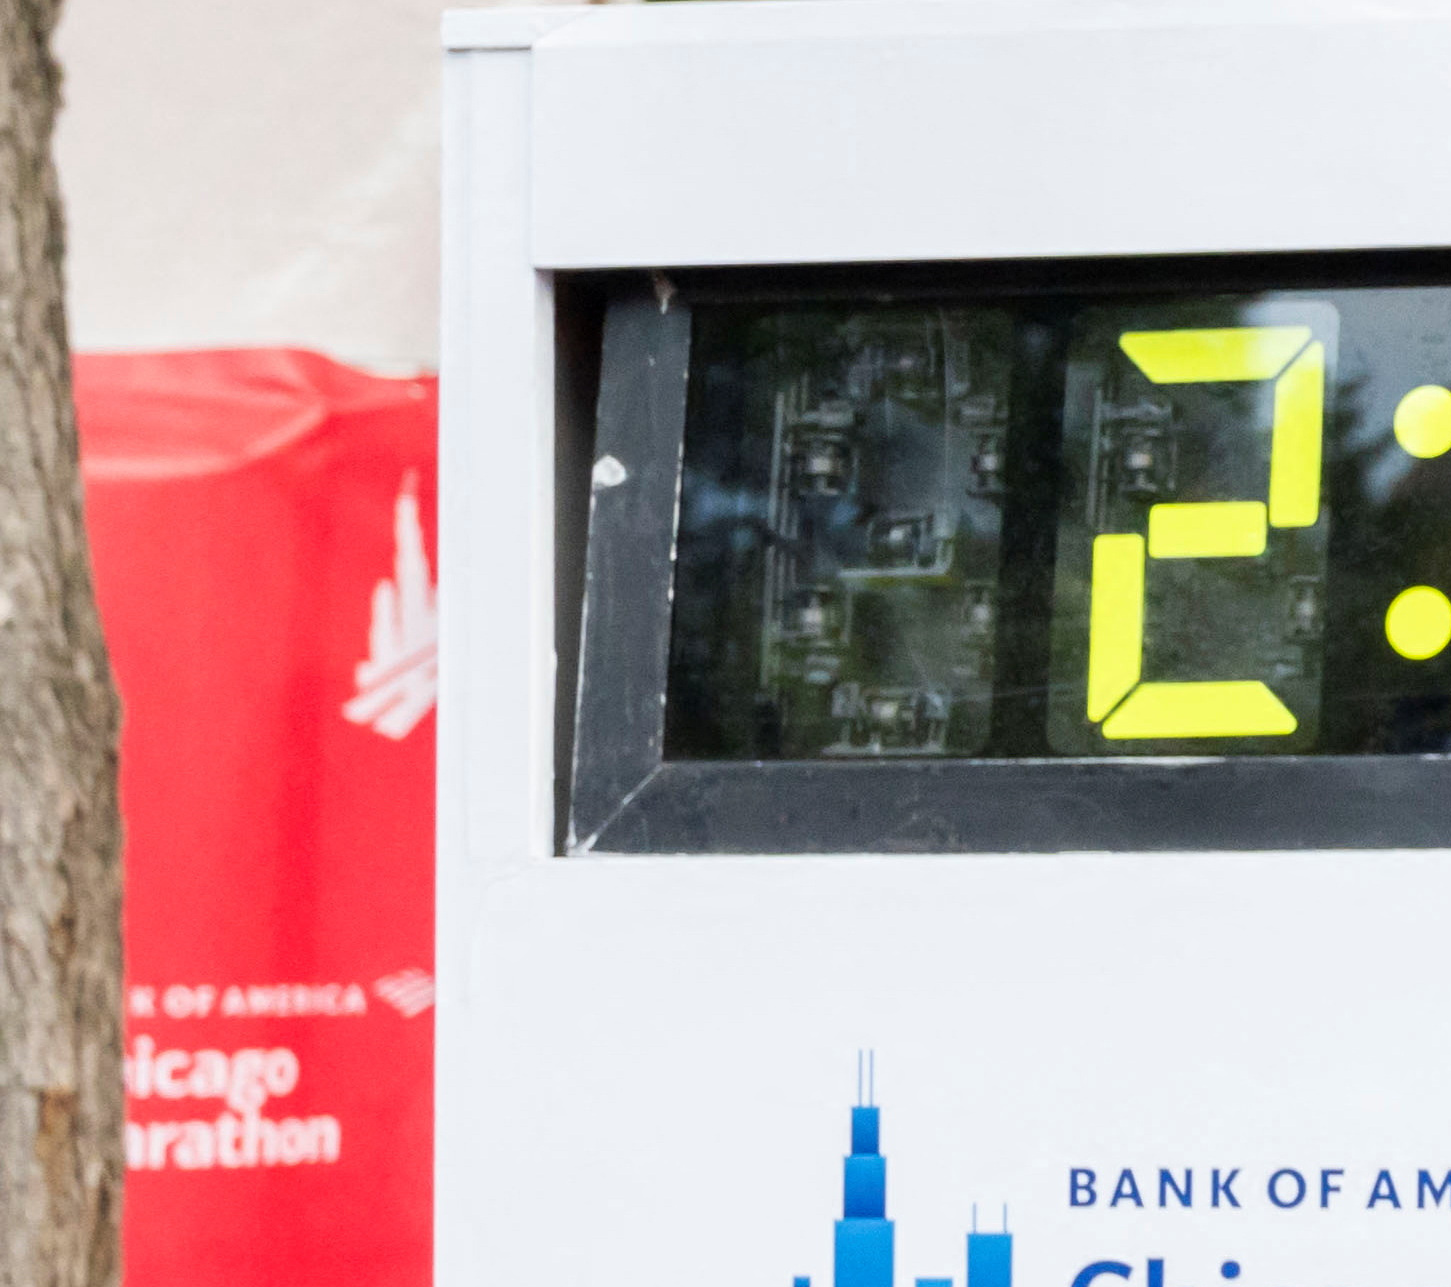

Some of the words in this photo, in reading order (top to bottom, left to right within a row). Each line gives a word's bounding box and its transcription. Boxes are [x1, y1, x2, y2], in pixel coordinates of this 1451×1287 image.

[162, 983, 216, 1019] OF
[221, 983, 367, 1018] AMERICA
[122, 1032, 301, 1113] icago
[1068, 1166, 1242, 1208] BANK
[1267, 1168, 1345, 1209] OF
